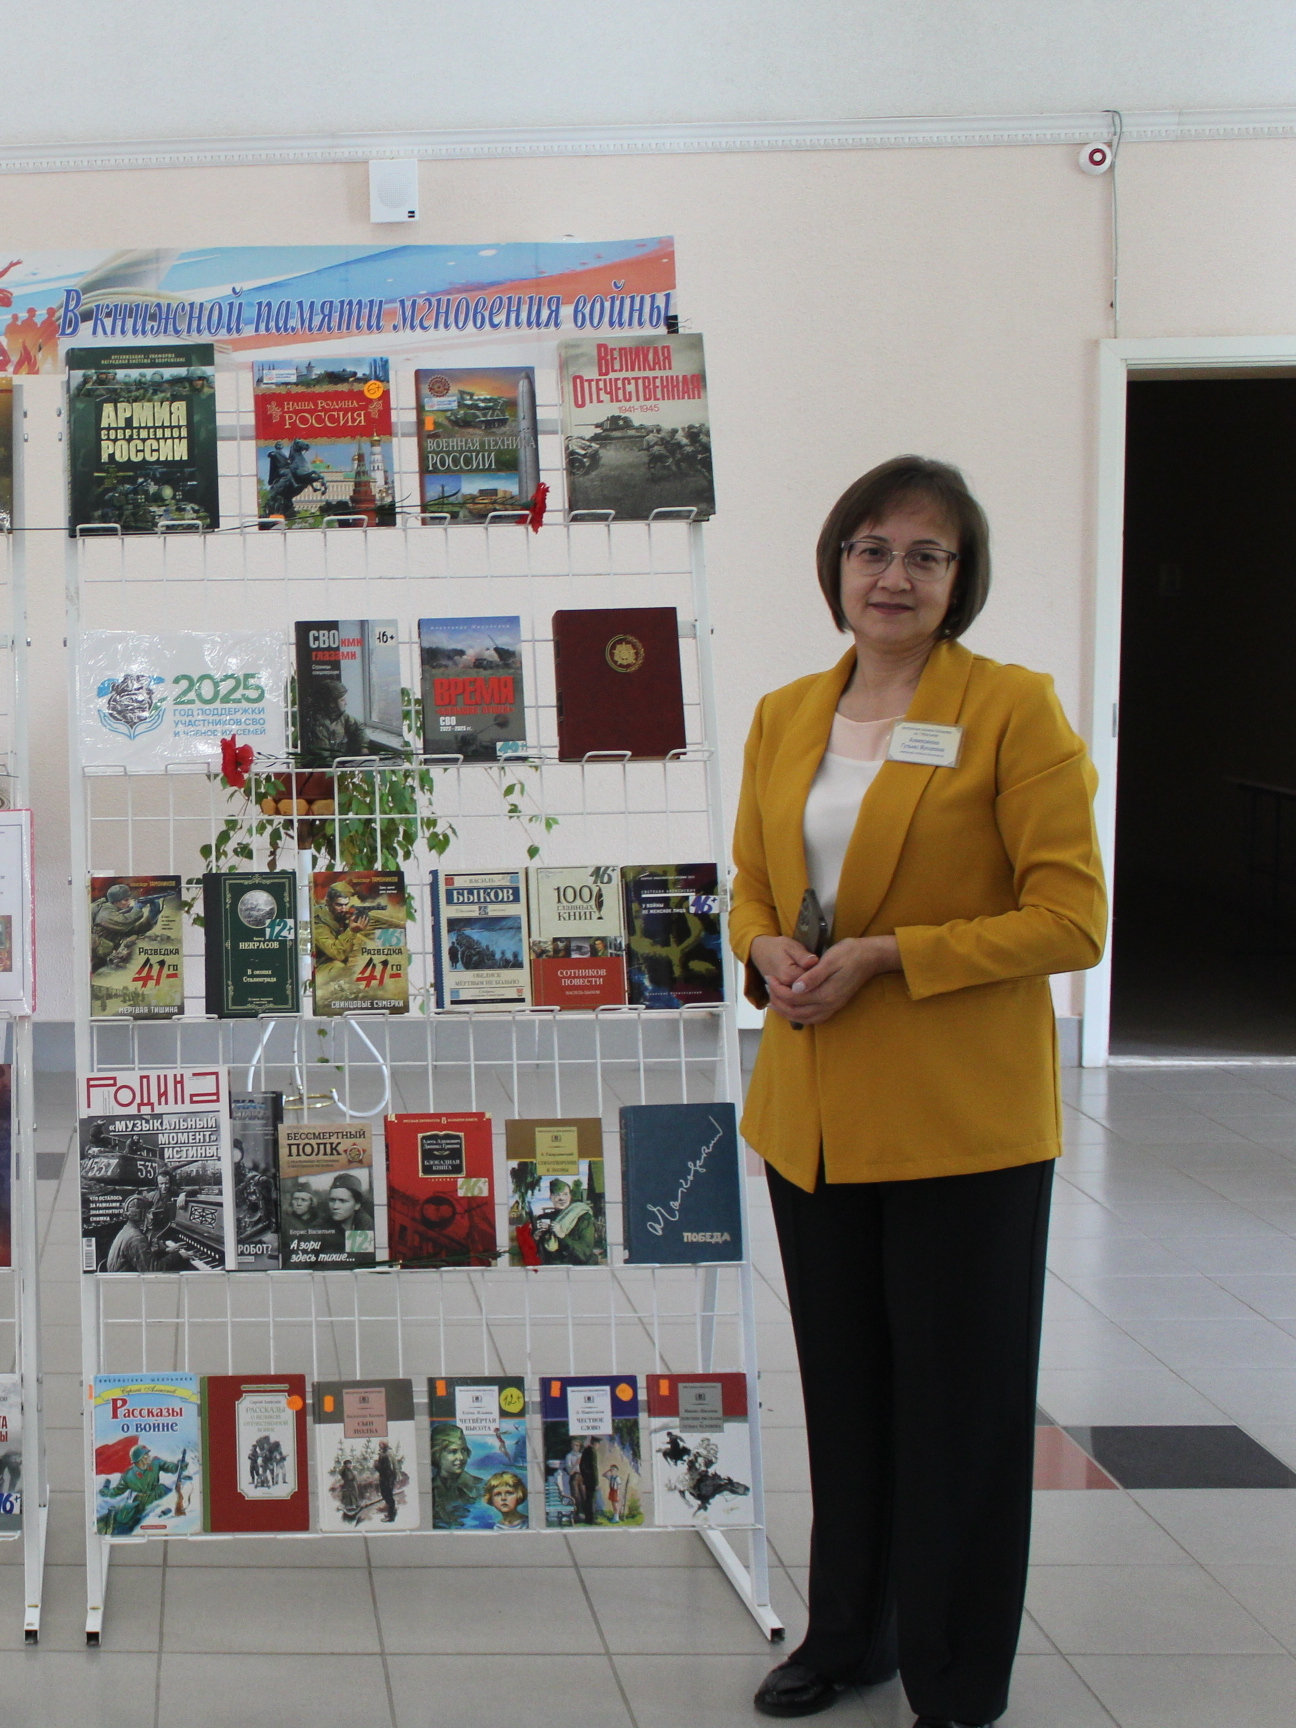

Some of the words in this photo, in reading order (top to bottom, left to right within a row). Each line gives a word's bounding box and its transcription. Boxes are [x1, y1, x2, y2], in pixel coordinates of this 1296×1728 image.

[58, 288, 85, 339] В
[92, 287, 245, 338] книжной
[254, 295, 385, 335] памяти
[392, 293, 561, 335] мгновения
[573, 280, 673, 329] войны
[596, 343, 672, 376] ВЕЛИКАЯ
[572, 374, 702, 408] ОТЕЧЕСТВЕННАЯ
[284, 401, 314, 411] НАША
[618, 404, 660, 414] 1941-1945
[101, 401, 187, 428] АРМИЯ
[284, 411, 366, 428] РОССИЯ
[101, 426, 187, 439] СОВРЕМЕННОЙ
[426, 438, 480, 450] ВОЕННАЯ
[484, 436, 536, 449] ТЕХНИКА
[101, 439, 189, 462] РОССИИ
[428, 452, 496, 471] РОССИИ
[312, 651, 356, 660] глазами
[172, 673, 266, 706] 2025
[433, 676, 514, 706] ВРЕМЯ
[174, 709, 194, 717] ГОД
[197, 707, 265, 716] ПОДДЕРЖКИ
[174, 719, 242, 727] УЧАСТНИКОВ
[440, 717, 456, 726] СВО
[236, 727, 266, 735] СЕМЕЙ
[589, 867, 617, 884] 16+
[454, 888, 514, 903] БЫКОВ
[555, 885, 593, 904] 100
[690, 895, 717, 913] 16+
[557, 910, 596, 921] КНИГ
[266, 911, 293, 939] 12+
[557, 969, 606, 977] СОТНИКОВ
[562, 978, 603, 986] ПОВЕСТИ
[331, 1000, 371, 1009] СВИНЦОВЫЕ
[374, 1000, 403, 1008] СУМЕРКИ
[109, 1116, 216, 1132] «МУЗЫКАЛЬНЫЙ
[158, 1132, 217, 1144] МОМЕНТ»
[287, 1128, 366, 1140] БЕССМЕРТНЫЙ
[165, 1146, 217, 1158] ИСТИНЫ
[287, 1142, 342, 1157] ПОЛК
[683, 1232, 731, 1243] ПОБЕДА
[238, 1244, 272, 1254] РОБОТ?
[290, 1240, 298, 1250] А
[299, 1241, 321, 1251] зори
[291, 1251, 316, 1262] здесь
[110, 1398, 183, 1419] Рассказы
[121, 1423, 130, 1432] о
[135, 1420, 178, 1432] войне
